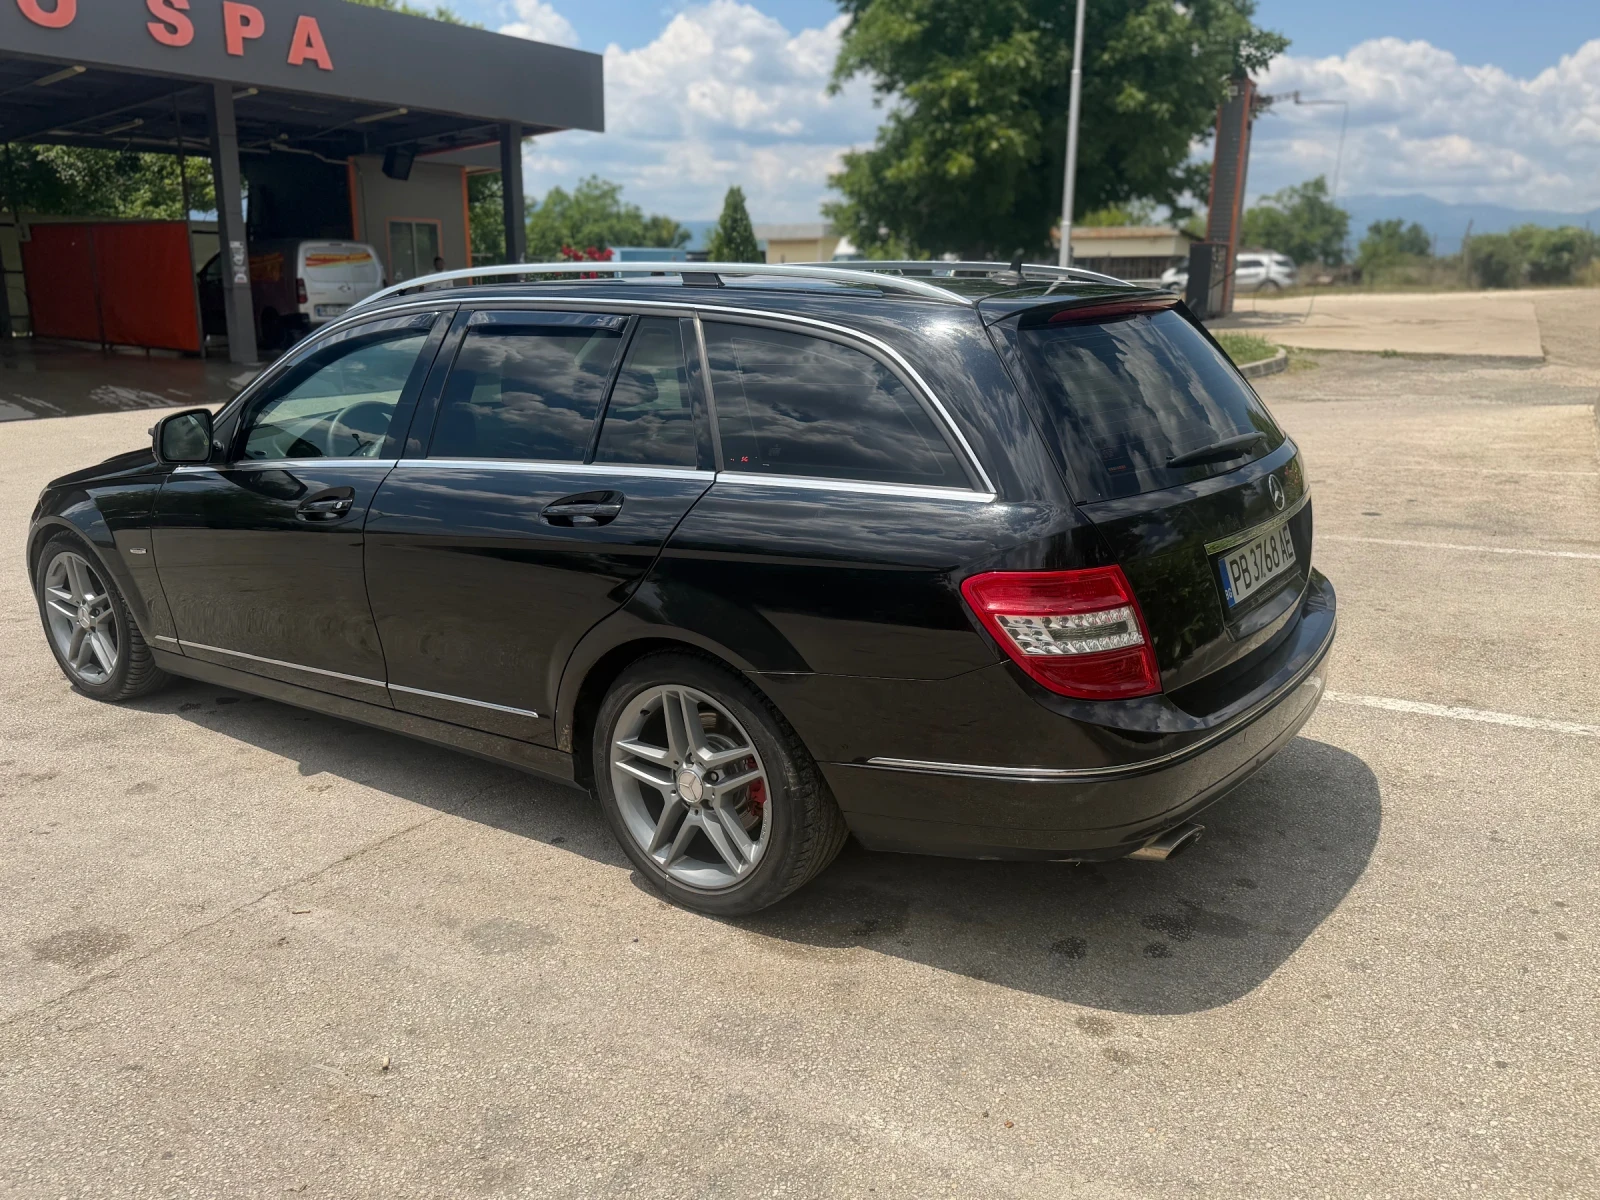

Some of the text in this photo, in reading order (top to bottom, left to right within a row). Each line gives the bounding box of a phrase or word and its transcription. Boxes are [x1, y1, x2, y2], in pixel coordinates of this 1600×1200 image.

[147, 0, 334, 70] SPA
[1229, 553, 1252, 596] PB
[1249, 535, 1280, 582] 3768
[1279, 525, 1294, 564] AE
